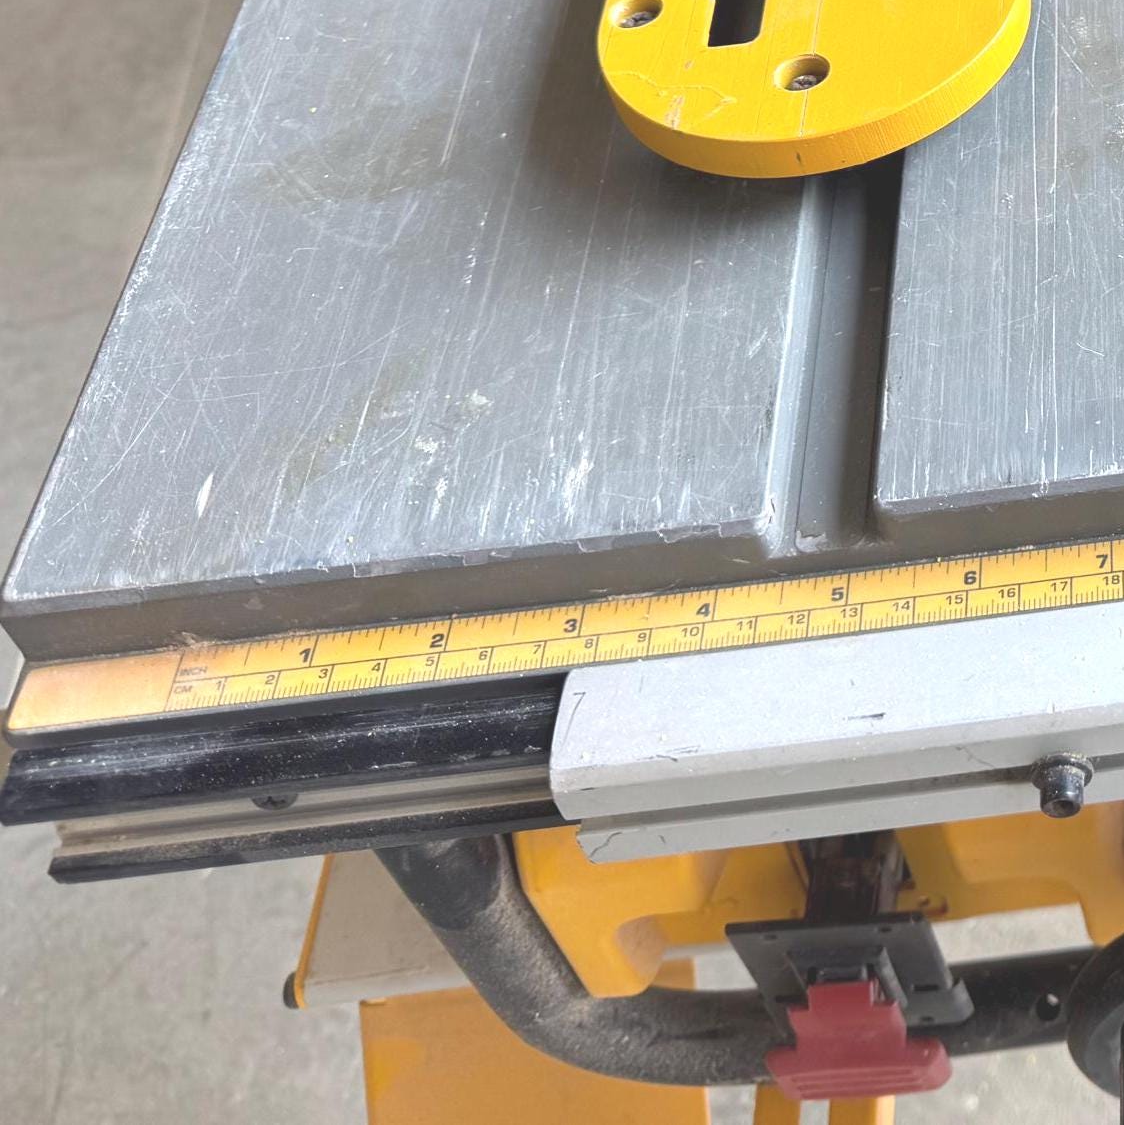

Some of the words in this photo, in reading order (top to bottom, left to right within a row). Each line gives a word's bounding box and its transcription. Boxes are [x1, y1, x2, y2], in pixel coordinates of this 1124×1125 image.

[174, 684, 193, 694] CM
[216, 680, 222, 690] 1
[265, 675, 275, 684] 2
[318, 668, 328, 679] 3
[371, 662, 381, 672] 4
[425, 656, 435, 666] 5
[479, 650, 488, 660] 6
[533, 644, 542, 655] 7
[584, 638, 594, 648] 8
[637, 632, 647, 642] 9
[681, 626, 699, 637] 10
[737, 620, 753, 631] 11
[788, 614, 805, 625] 12
[841, 607, 858, 618] 13
[892, 601, 910, 611] 14
[946, 594, 963, 605] 15
[998, 587, 1016, 598] 16
[1051, 581, 1068, 592] 17
[1103, 574, 1120, 585] 18
[180, 666, 208, 676] INCH
[299, 648, 311, 662] 1
[430, 633, 445, 648] 2
[563, 618, 577, 633] 3
[696, 603, 711, 617] 4
[831, 587, 844, 602] 5
[963, 570, 977, 585] 6
[1096, 554, 1108, 568] 7
